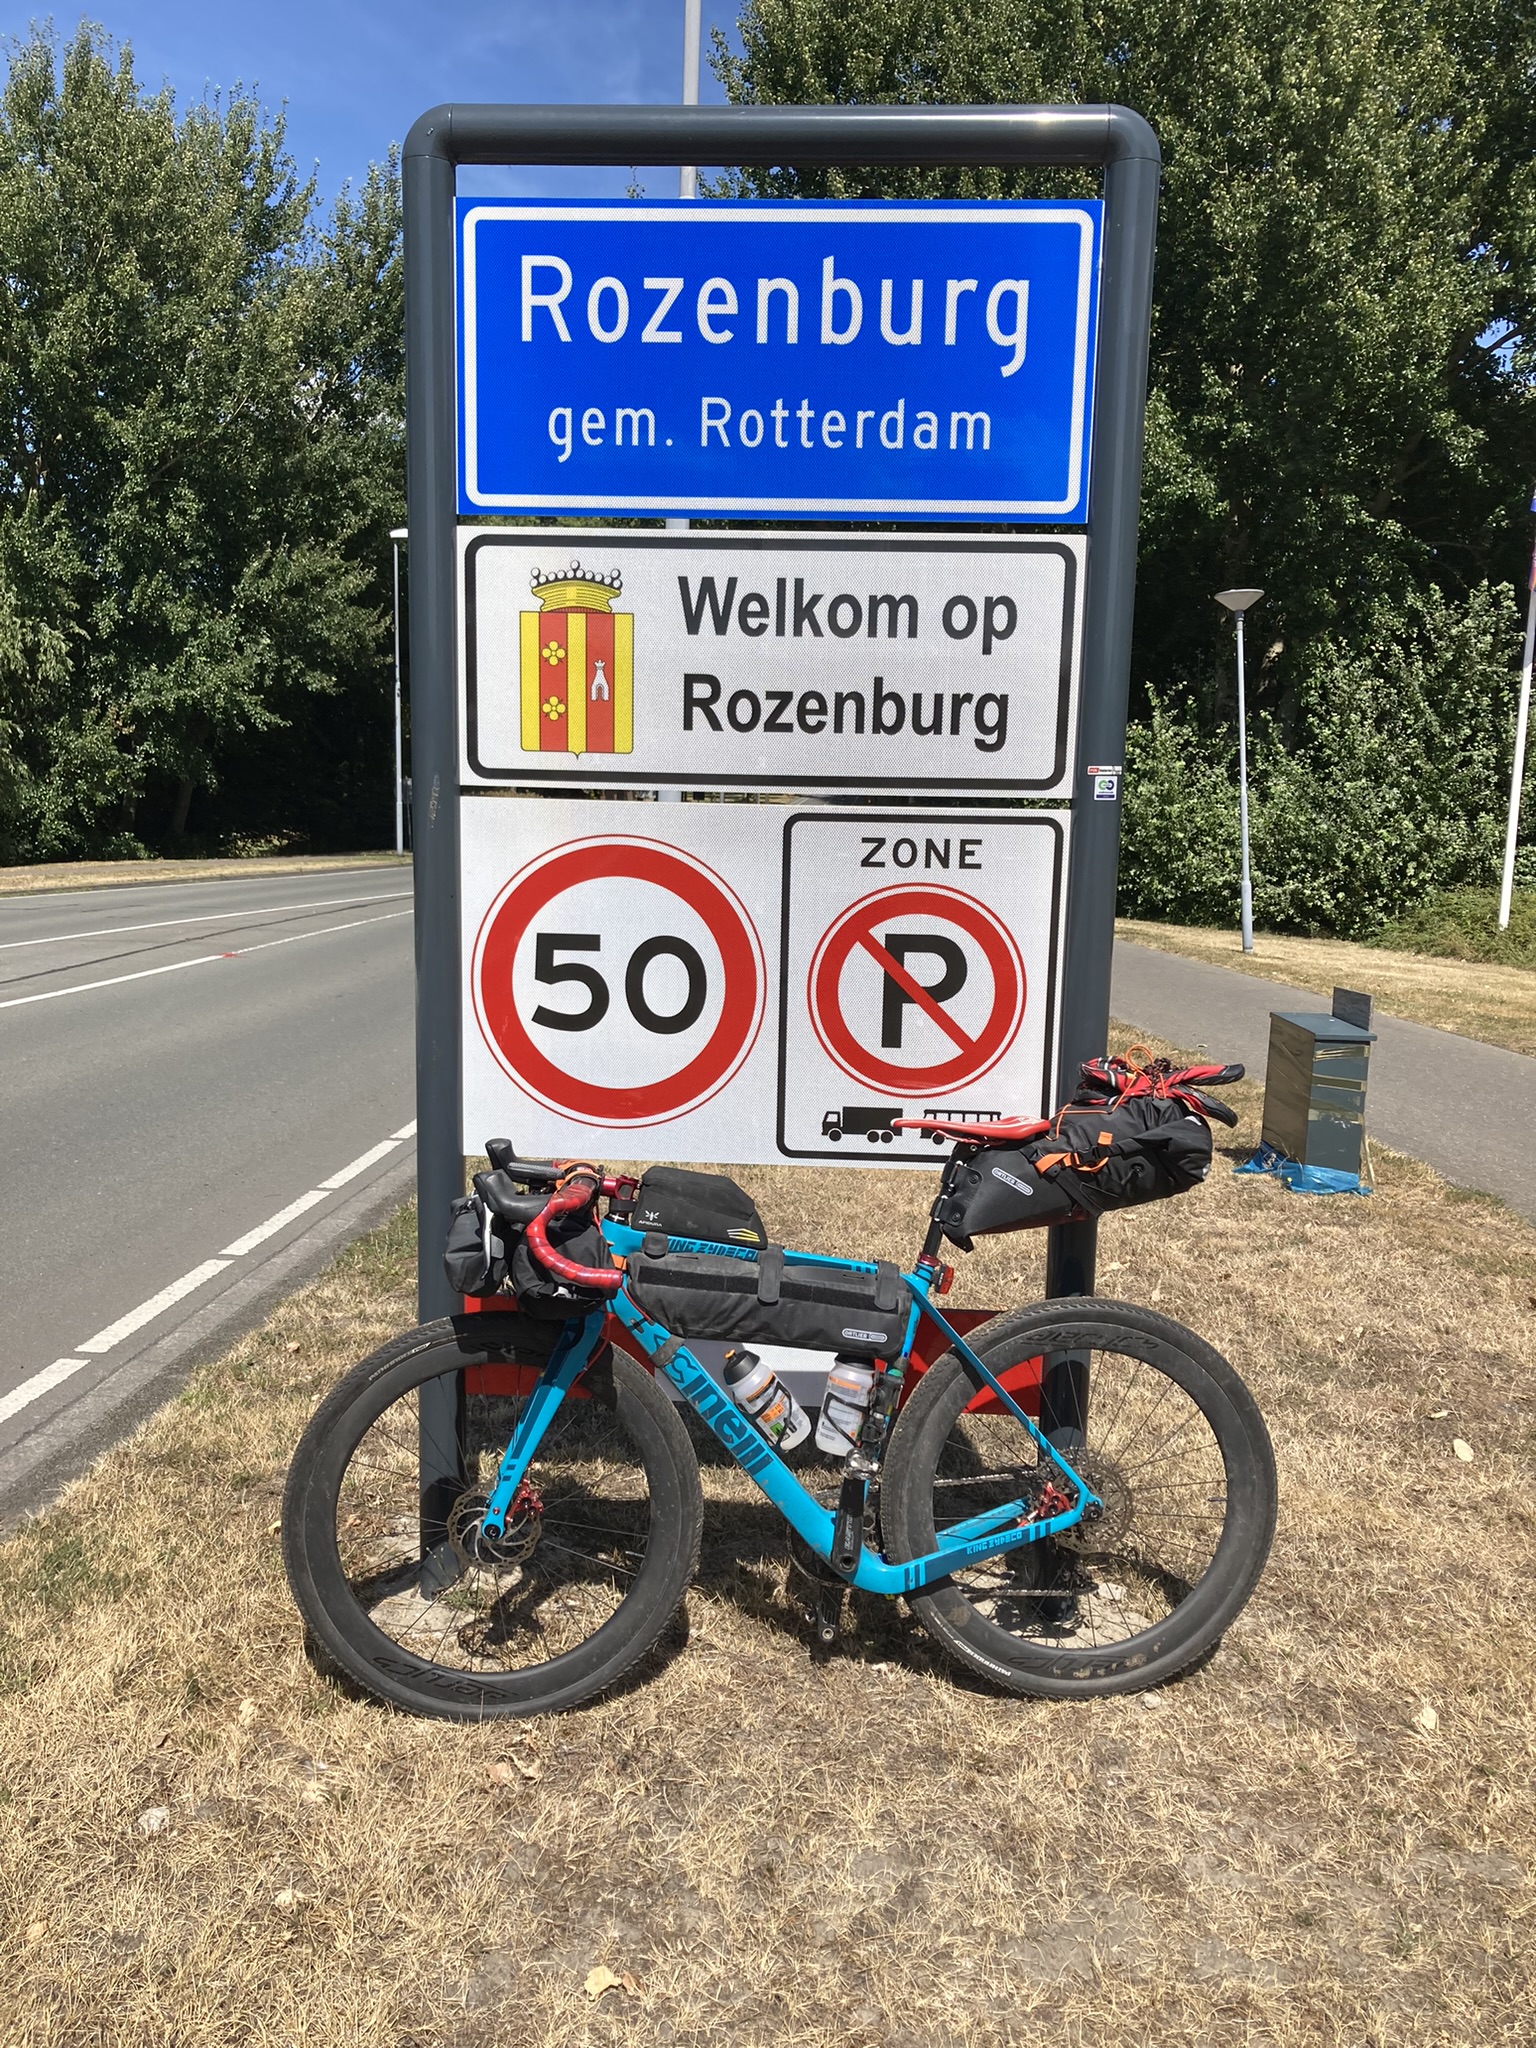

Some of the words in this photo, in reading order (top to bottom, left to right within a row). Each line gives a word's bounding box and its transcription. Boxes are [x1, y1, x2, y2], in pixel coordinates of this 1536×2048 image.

[520, 254, 1031, 378] Rozenburg
[548, 405, 674, 463] gem.
[700, 396, 992, 451] Rotterdam
[677, 575, 918, 639] Welkom
[941, 594, 1018, 656] op
[682, 673, 1009, 752] Rozenburg
[860, 836, 983, 870] ZONE
[531, 931, 708, 1034] 50
[881, 932, 969, 1048] P
